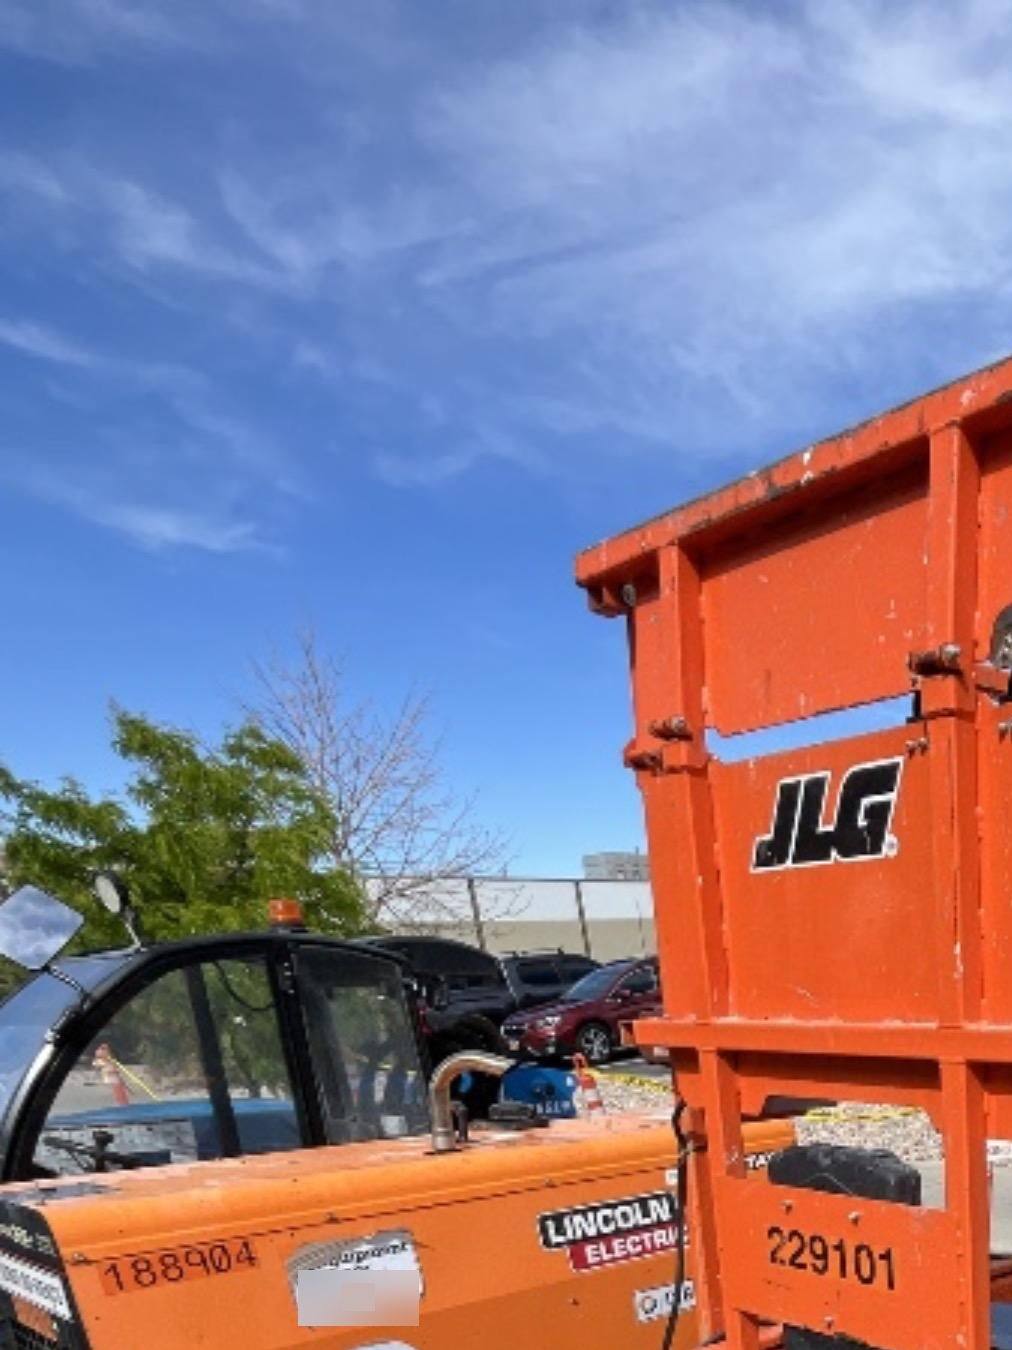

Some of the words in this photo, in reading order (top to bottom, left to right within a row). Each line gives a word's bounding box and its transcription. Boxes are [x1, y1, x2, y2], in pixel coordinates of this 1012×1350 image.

[750, 755, 904, 873] JLG
[546, 1199, 672, 1244] LINCOLN
[103, 1241, 257, 1292] 188904
[767, 1226, 896, 1291] 229101
